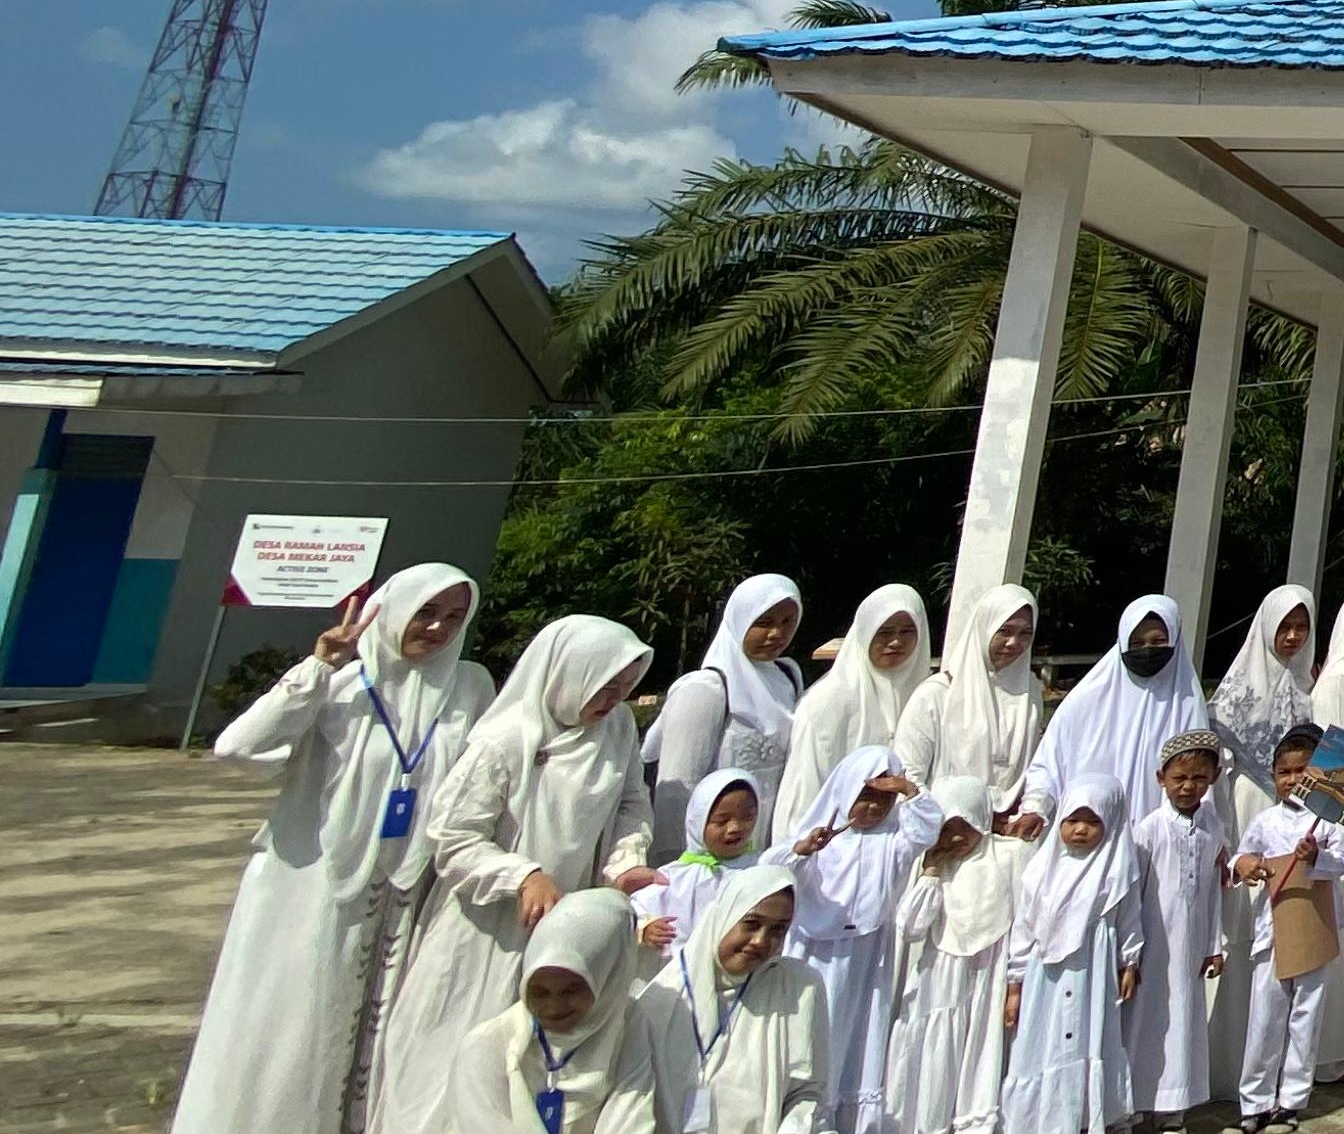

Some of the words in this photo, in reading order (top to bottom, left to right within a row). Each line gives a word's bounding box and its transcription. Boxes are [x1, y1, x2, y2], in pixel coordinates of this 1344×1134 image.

[252, 540, 281, 549] DESA
[284, 541, 325, 550] RAMAH
[327, 542, 366, 552] LANSIA
[257, 552, 286, 560] DESA
[287, 552, 327, 562] MEKAR
[328, 554, 355, 562] JAYA
